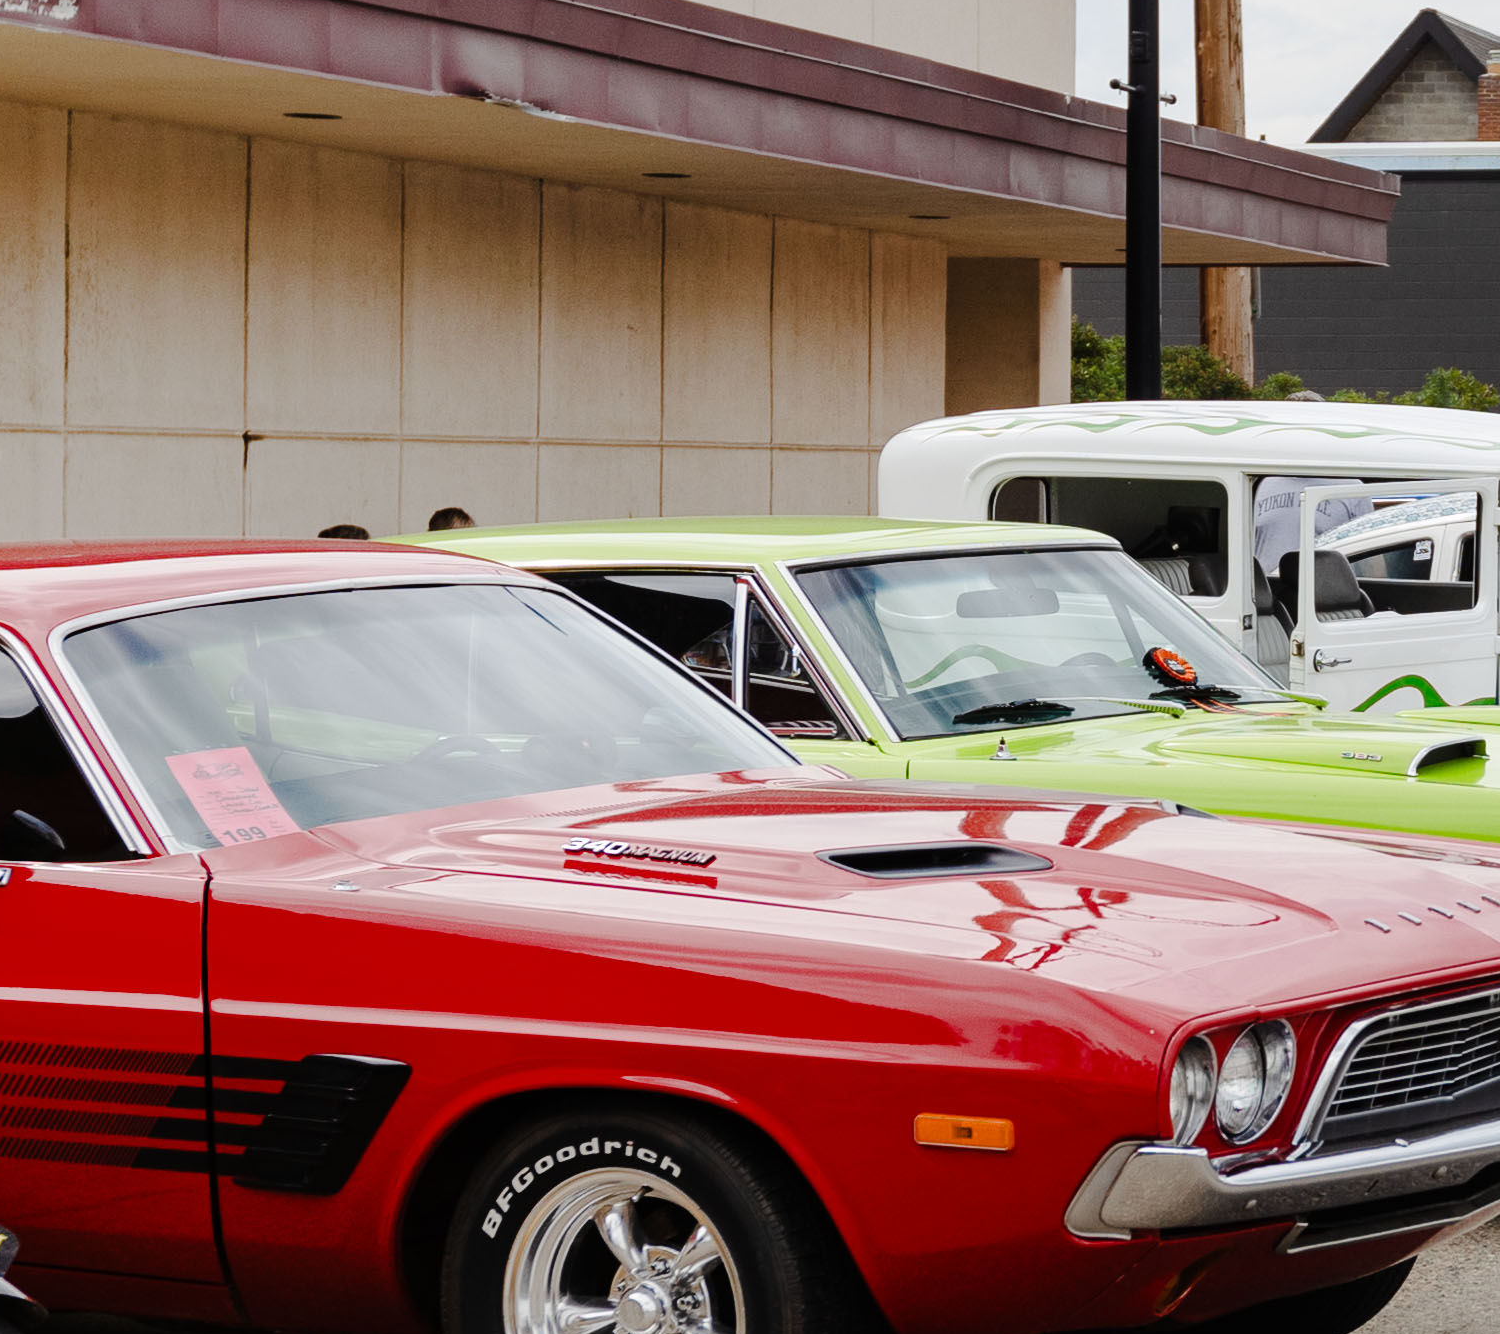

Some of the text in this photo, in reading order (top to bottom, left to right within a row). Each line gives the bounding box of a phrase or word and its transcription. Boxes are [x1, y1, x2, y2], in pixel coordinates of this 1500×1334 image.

[1258, 492, 1296, 517] YUKON
[223, 826, 267, 843] 199
[561, 837, 629, 855] 340
[482, 1137, 681, 1239] BFGoodrich
